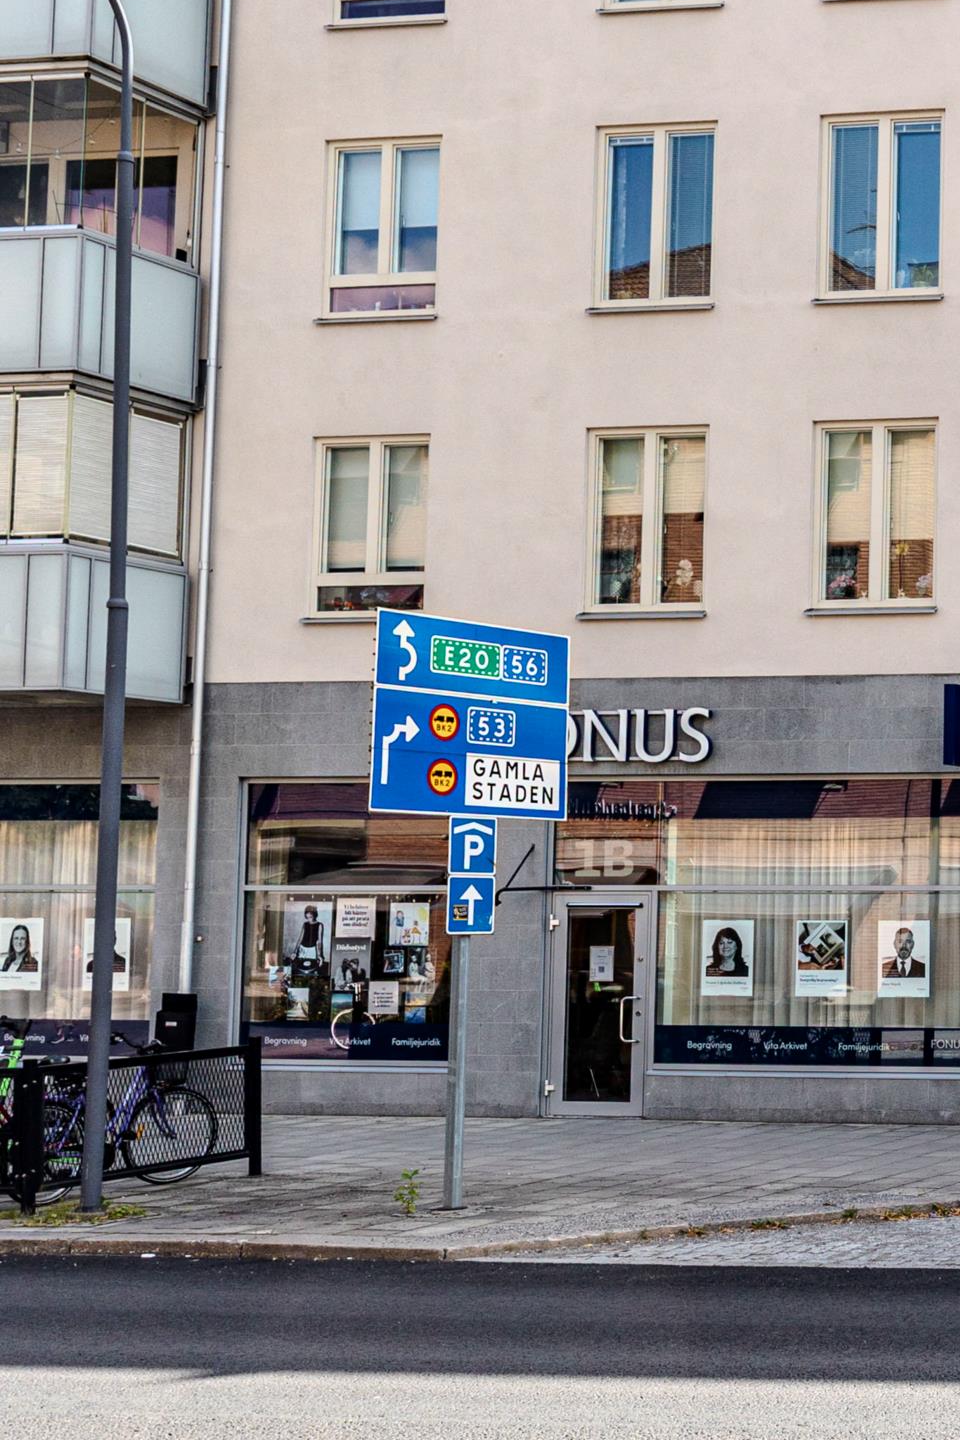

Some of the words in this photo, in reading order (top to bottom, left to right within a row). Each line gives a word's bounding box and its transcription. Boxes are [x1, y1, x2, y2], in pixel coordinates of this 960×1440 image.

[444, 646, 489, 670] E20
[511, 655, 538, 676] 56
[436, 724, 452, 732] BK2
[478, 716, 506, 737] 53
[568, 707, 710, 763] NUS
[473, 758, 544, 782] GAMLA
[434, 778, 450, 787] BK2
[472, 781, 554, 805] STADEN
[463, 834, 485, 870] P
[574, 840, 634, 877] 1B
[264, 1036, 307, 1047] Begravning
[345, 1037, 371, 1046] Arkivet
[391, 1037, 441, 1049] Familjejuridik
[687, 1040, 732, 1051] Begravning
[780, 1041, 807, 1050] Arkivet
[838, 1042, 890, 1052] Familjejuridik
